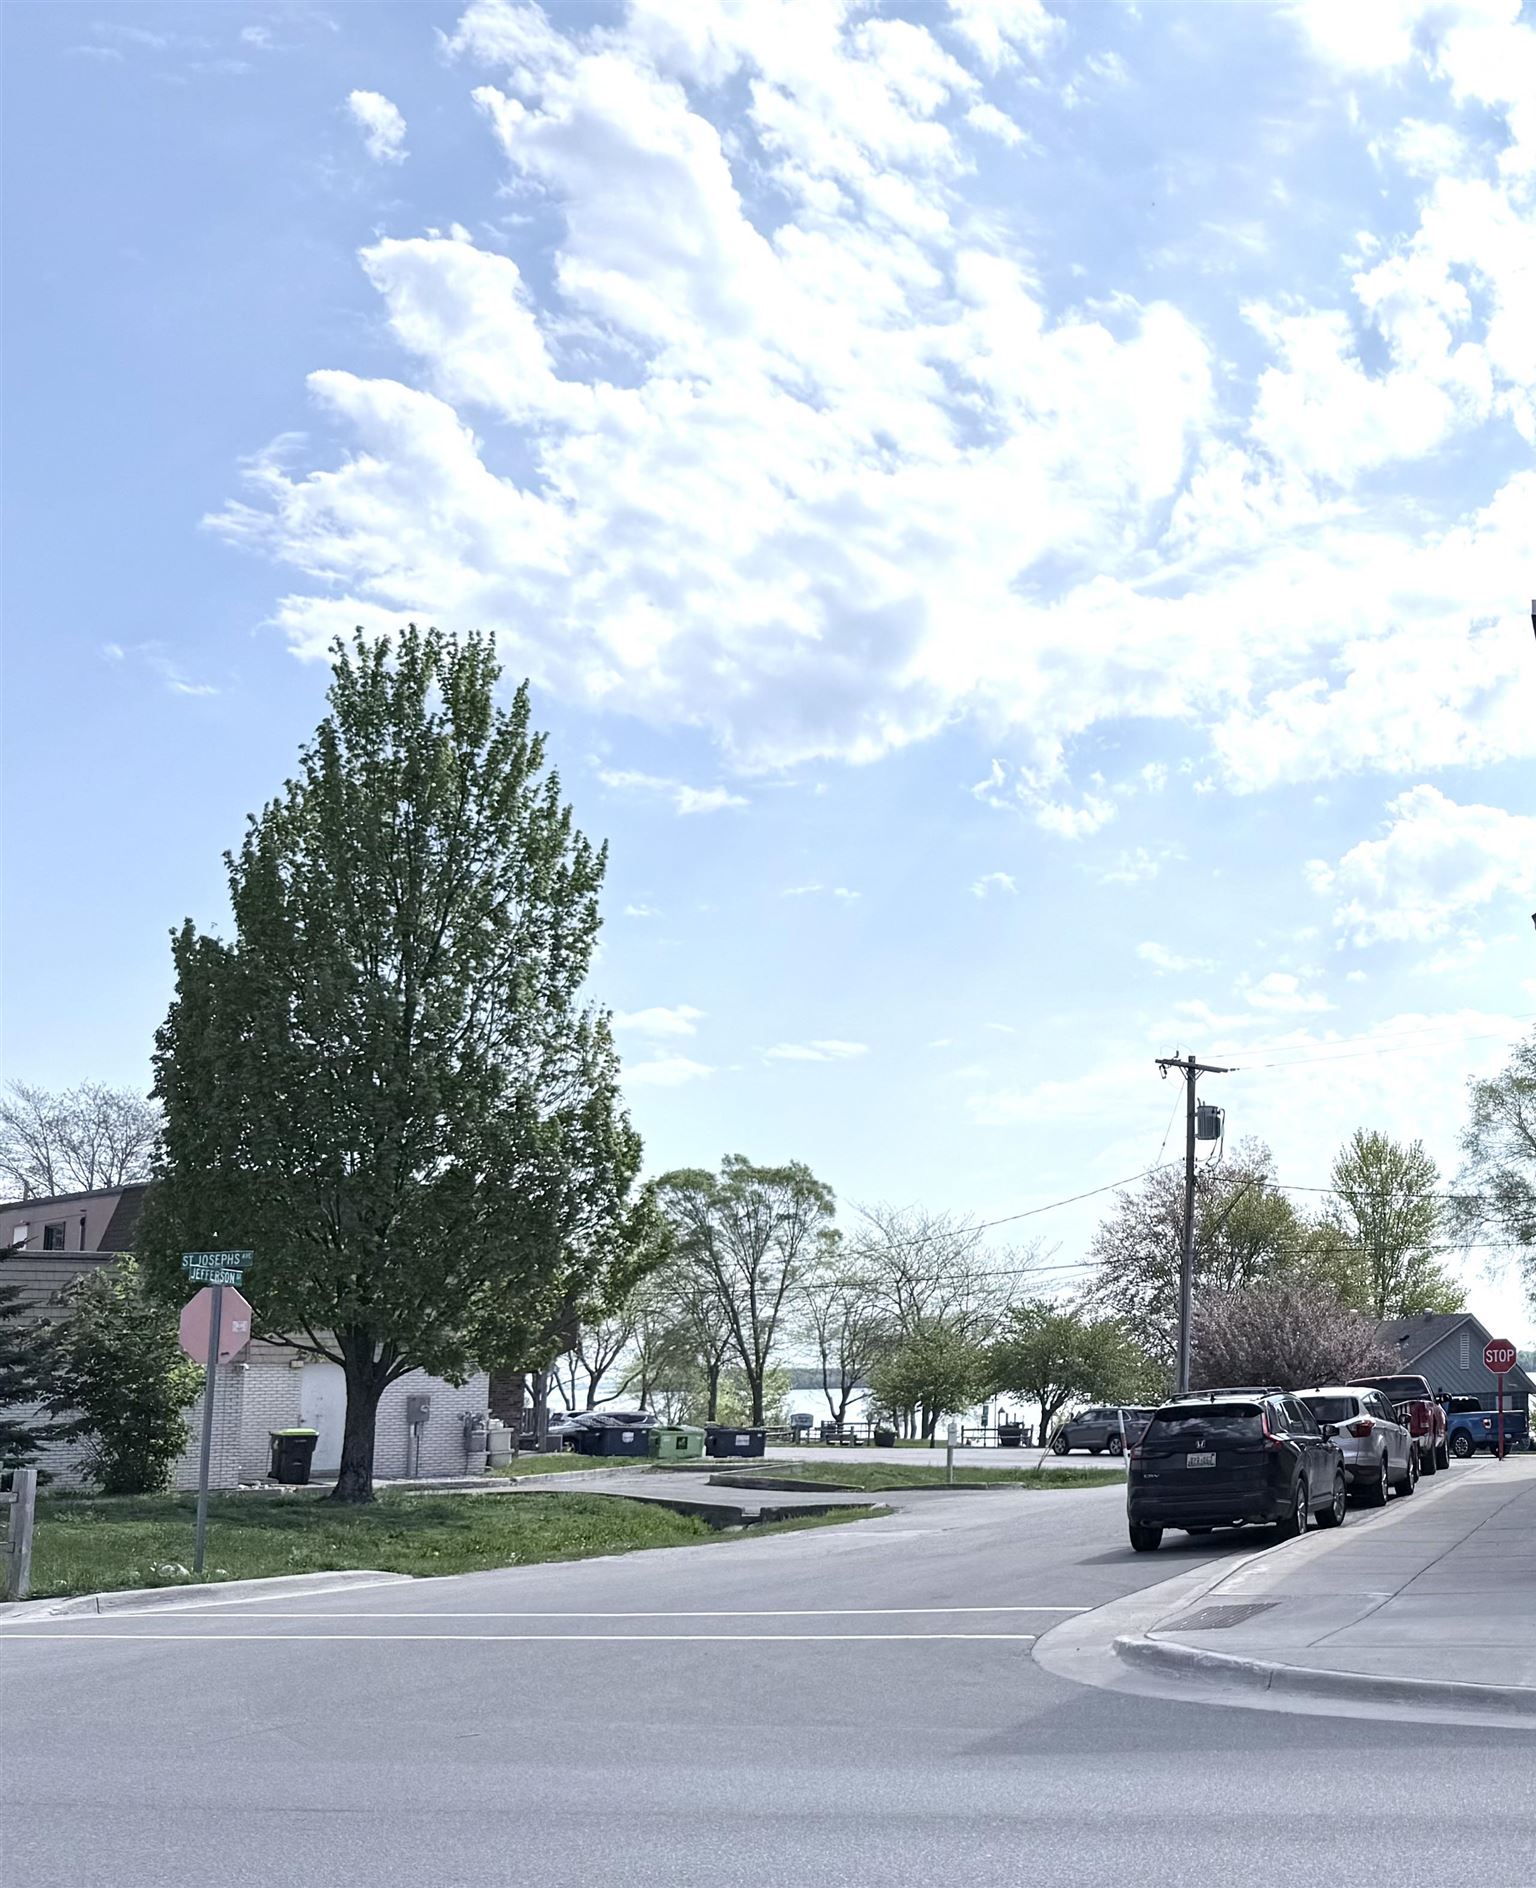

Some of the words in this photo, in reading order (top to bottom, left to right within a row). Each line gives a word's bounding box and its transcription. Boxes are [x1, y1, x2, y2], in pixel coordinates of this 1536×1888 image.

[182, 1255, 194, 1267] ST
[198, 1253, 240, 1266] JOSEPHS
[190, 1268, 235, 1284] JEFFERSON
[1485, 1349, 1515, 1363] STOP
